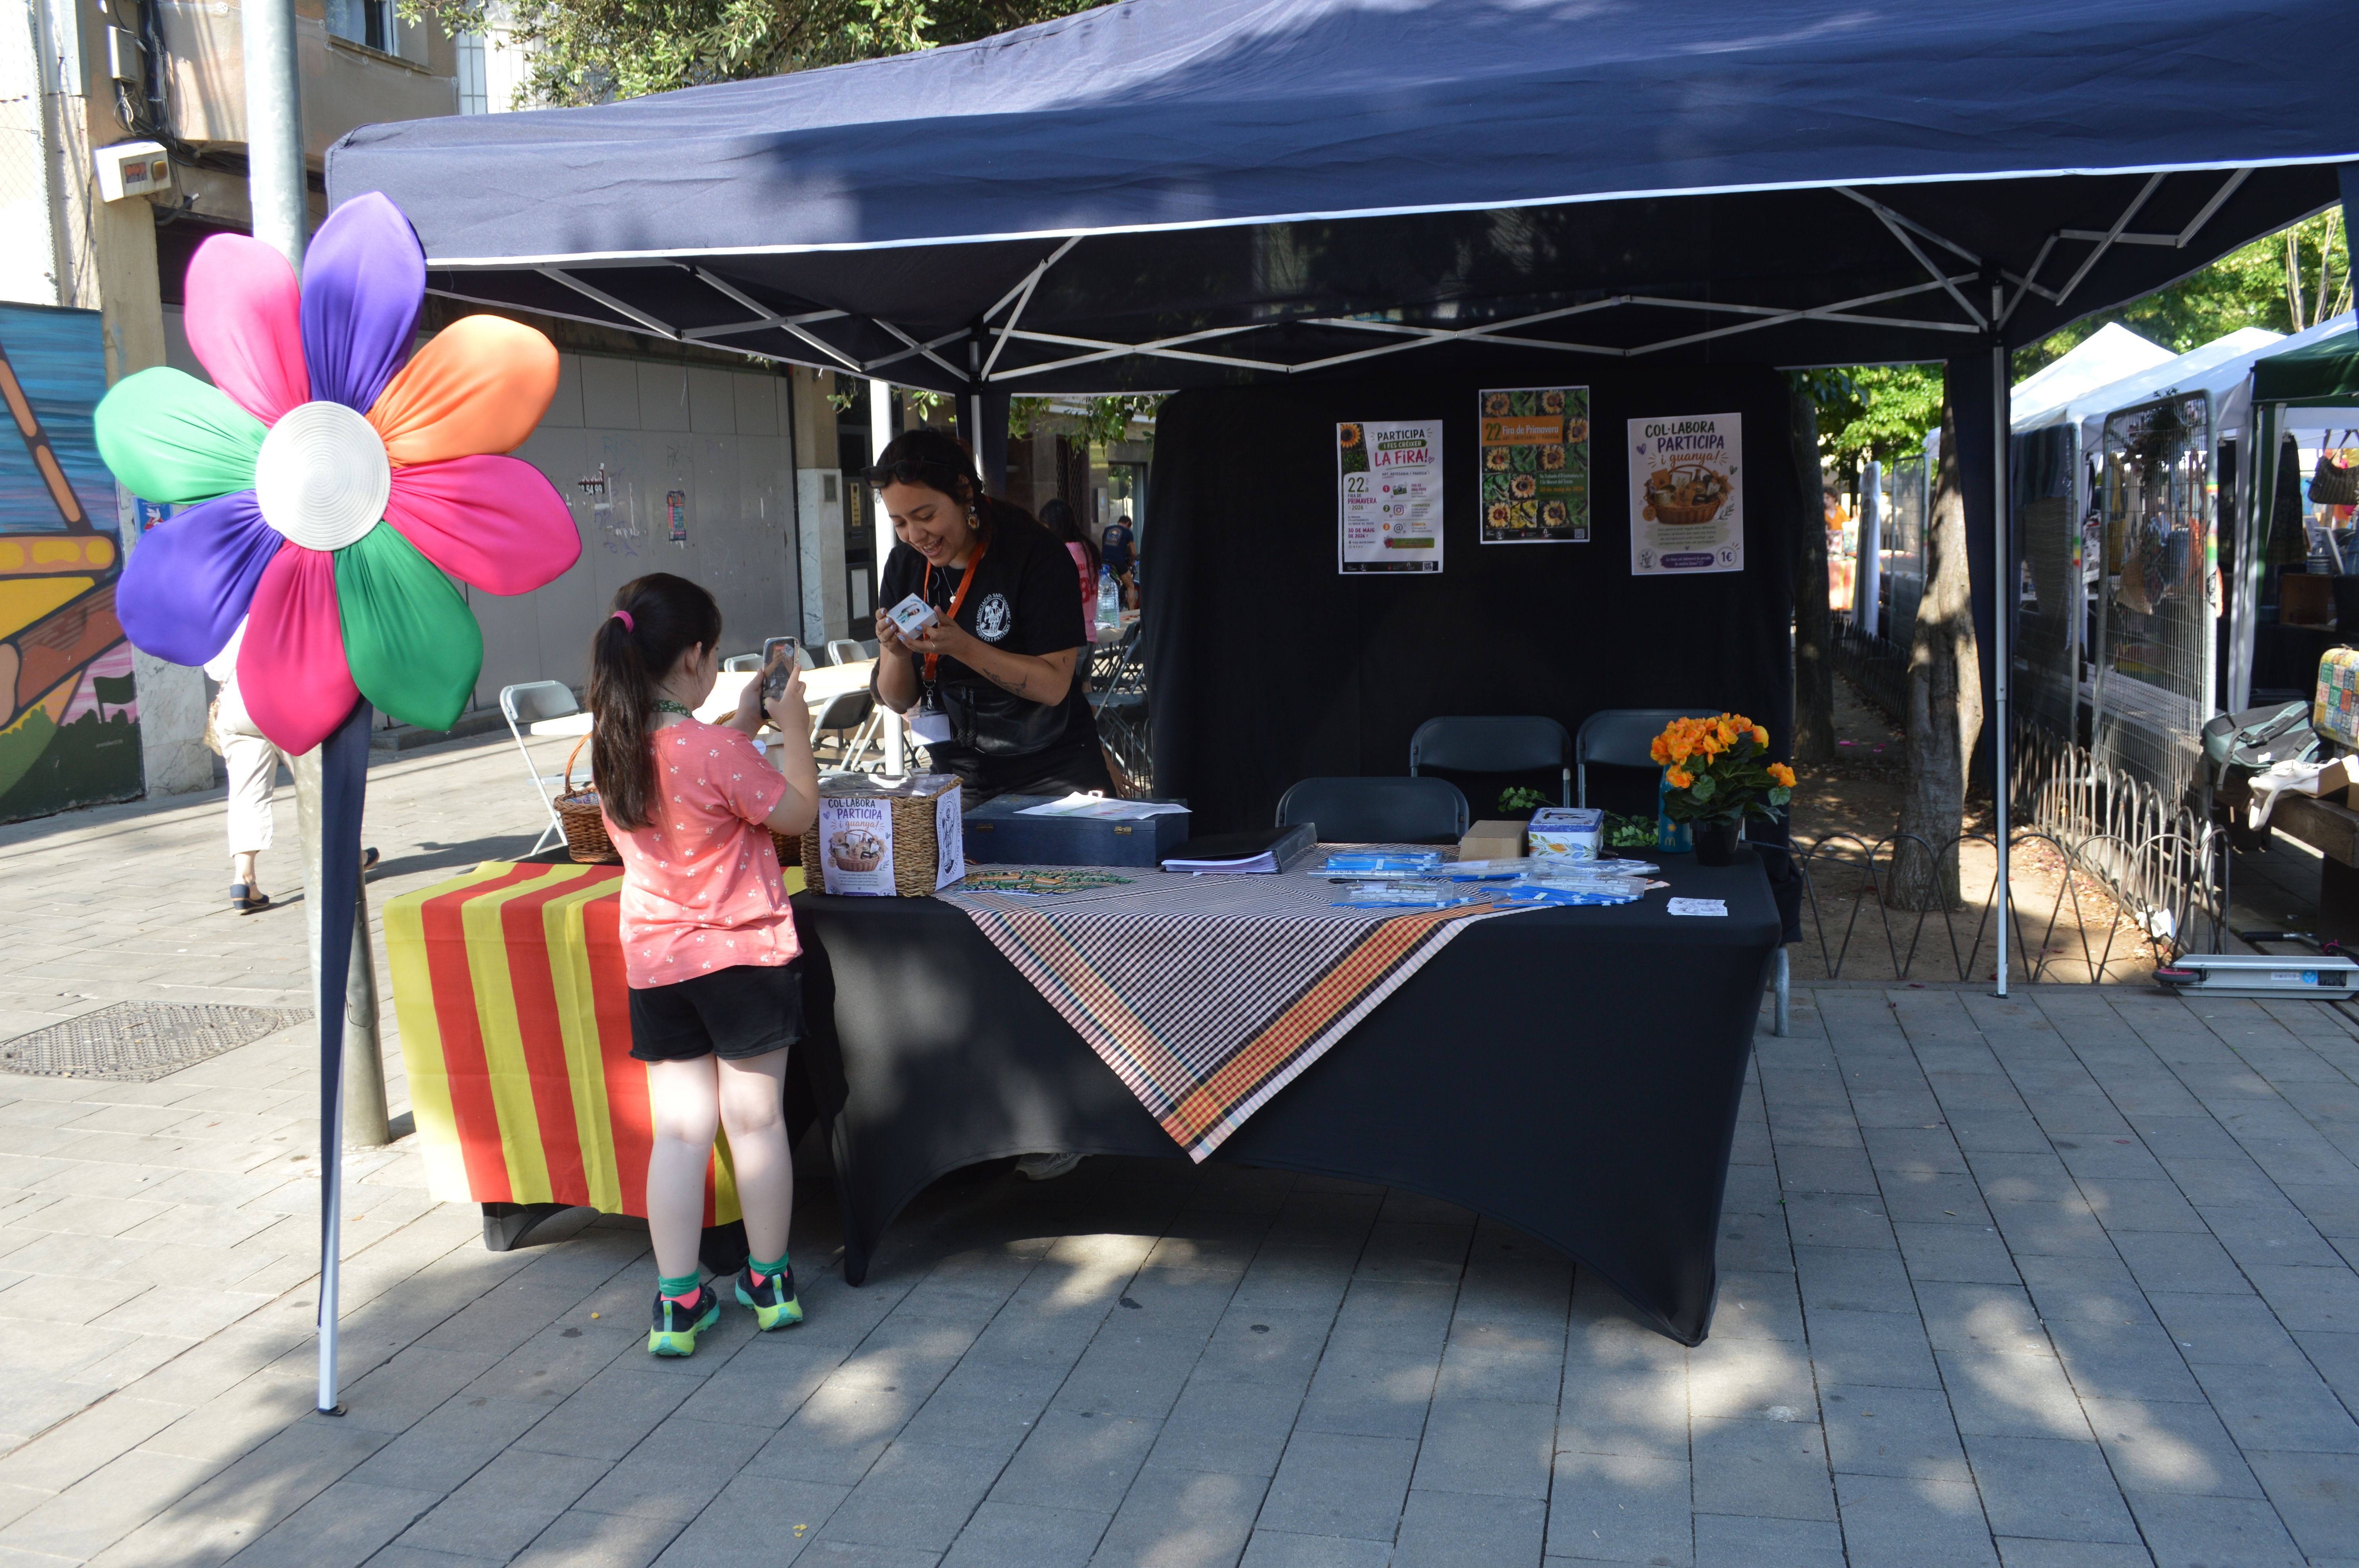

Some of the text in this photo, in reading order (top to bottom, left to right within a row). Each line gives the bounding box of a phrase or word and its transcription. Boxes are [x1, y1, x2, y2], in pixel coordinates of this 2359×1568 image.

[1377, 429, 1425, 441] PARTICIPA
[1486, 423, 1501, 441] 22
[1503, 425, 1559, 434] Fira de Primavera
[1645, 421, 1715, 438] COL·LABORA
[1657, 434, 1724, 453] PARTICIPA
[1375, 451, 1391, 467] LA
[1661, 450, 1720, 468] i guanya!
[1721, 551, 1732, 562] 1€
[994, 624, 1010, 642] PAGESOS
[828, 799, 876, 808] COL·LABORA
[837, 808, 882, 820] PARTICIPA
[845, 820, 879, 831] guanya!
